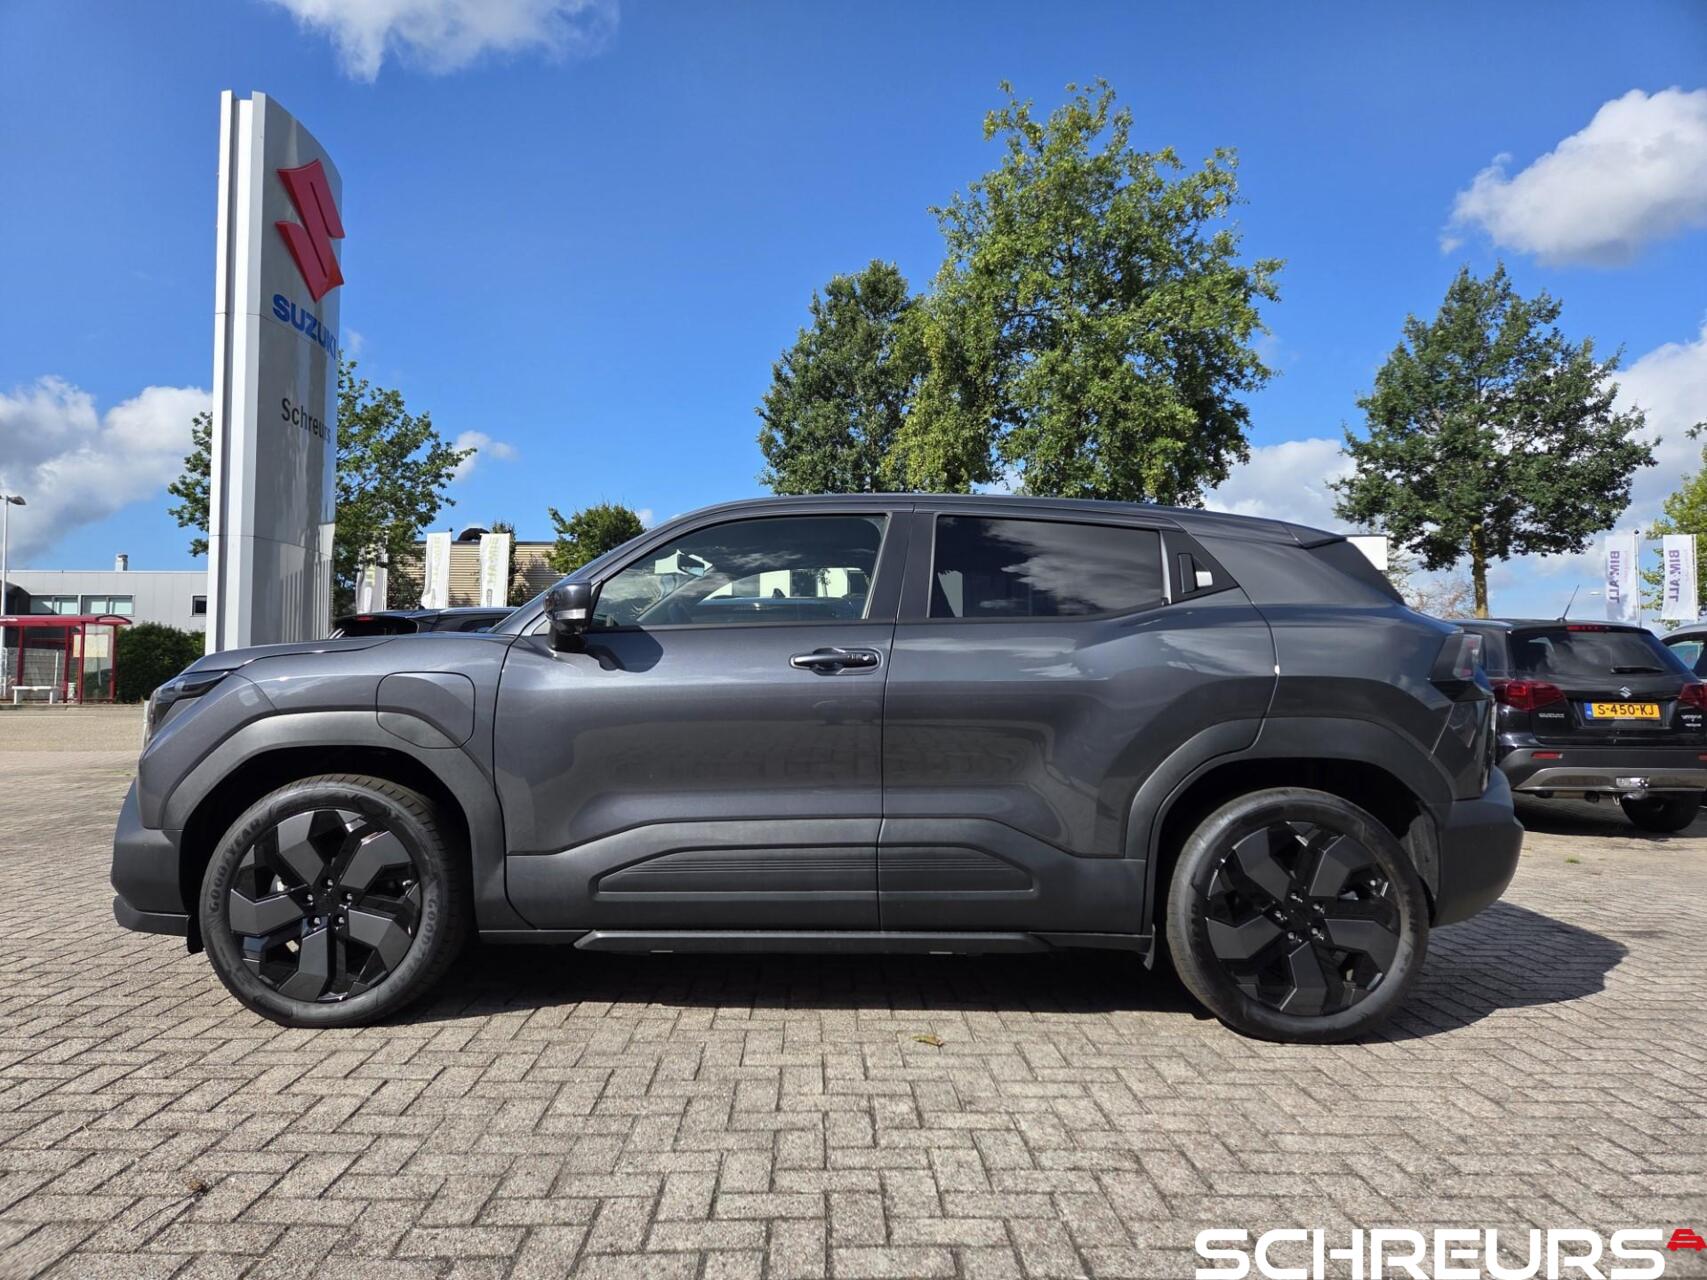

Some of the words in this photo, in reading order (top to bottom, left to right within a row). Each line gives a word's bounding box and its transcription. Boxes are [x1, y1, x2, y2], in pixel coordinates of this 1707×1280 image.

[273, 294, 336, 360] SUZUKI
[281, 397, 331, 444] Schreurs
[1597, 704, 1655, 715] S-450-KJ
